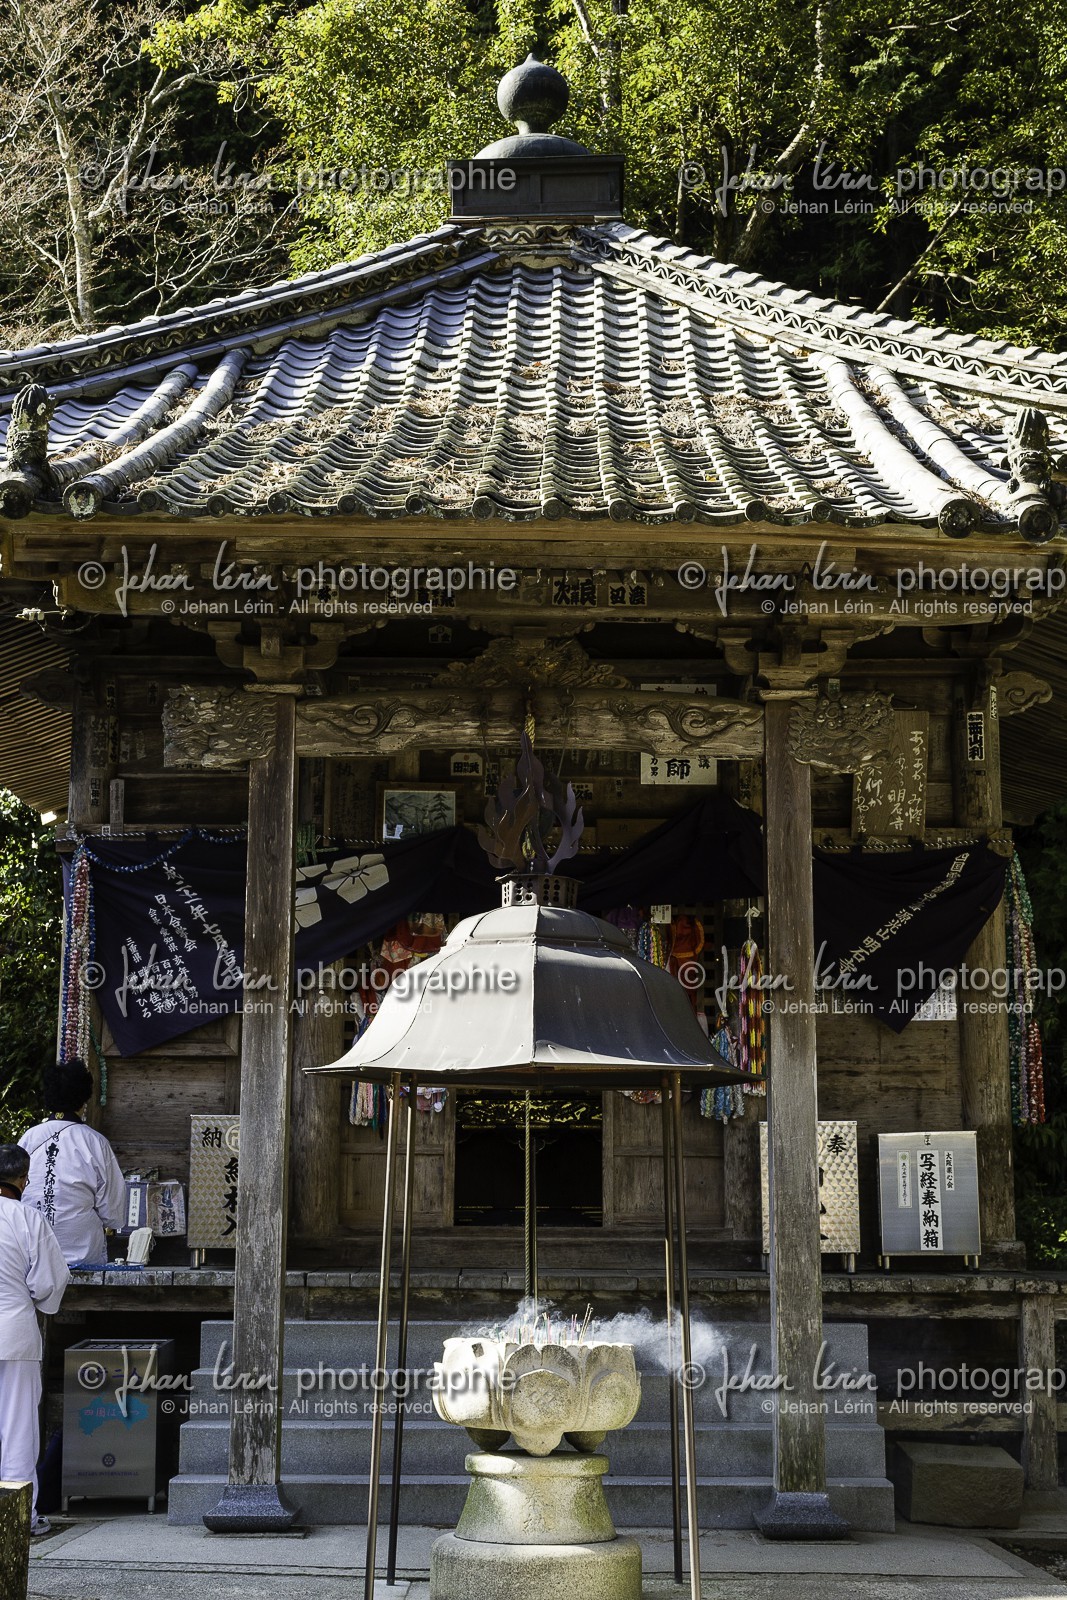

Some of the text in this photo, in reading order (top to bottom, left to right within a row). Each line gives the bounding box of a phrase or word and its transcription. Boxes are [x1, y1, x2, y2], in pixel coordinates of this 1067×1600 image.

[162, 861, 243, 982] 成二十一年七月吉日
[201, 1126, 223, 1148] 納
[826, 1134, 847, 1156] 奉
[920, 1153, 939, 1249] 写経奉納箱
